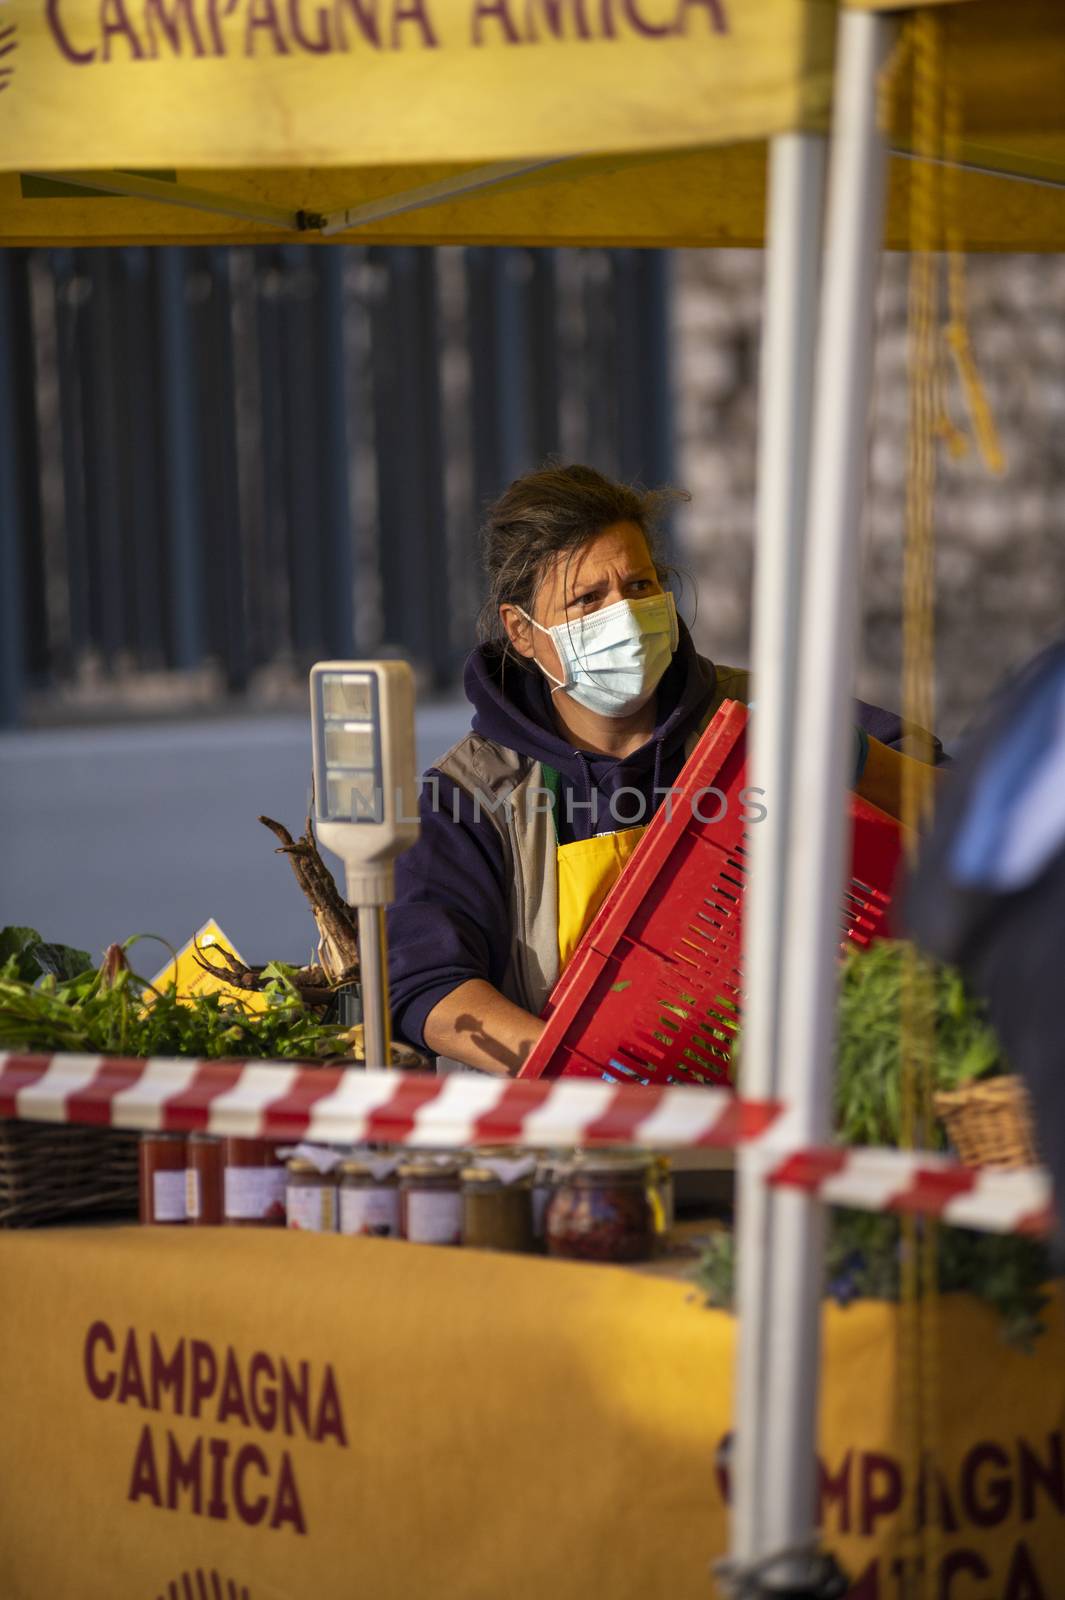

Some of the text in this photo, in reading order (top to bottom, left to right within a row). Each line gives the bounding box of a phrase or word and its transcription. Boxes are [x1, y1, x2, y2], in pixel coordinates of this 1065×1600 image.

[84, 1320, 348, 1448] CAMPAGNA
[128, 1423, 308, 1535] AMICA
[714, 1427, 1065, 1538] MPAGN
